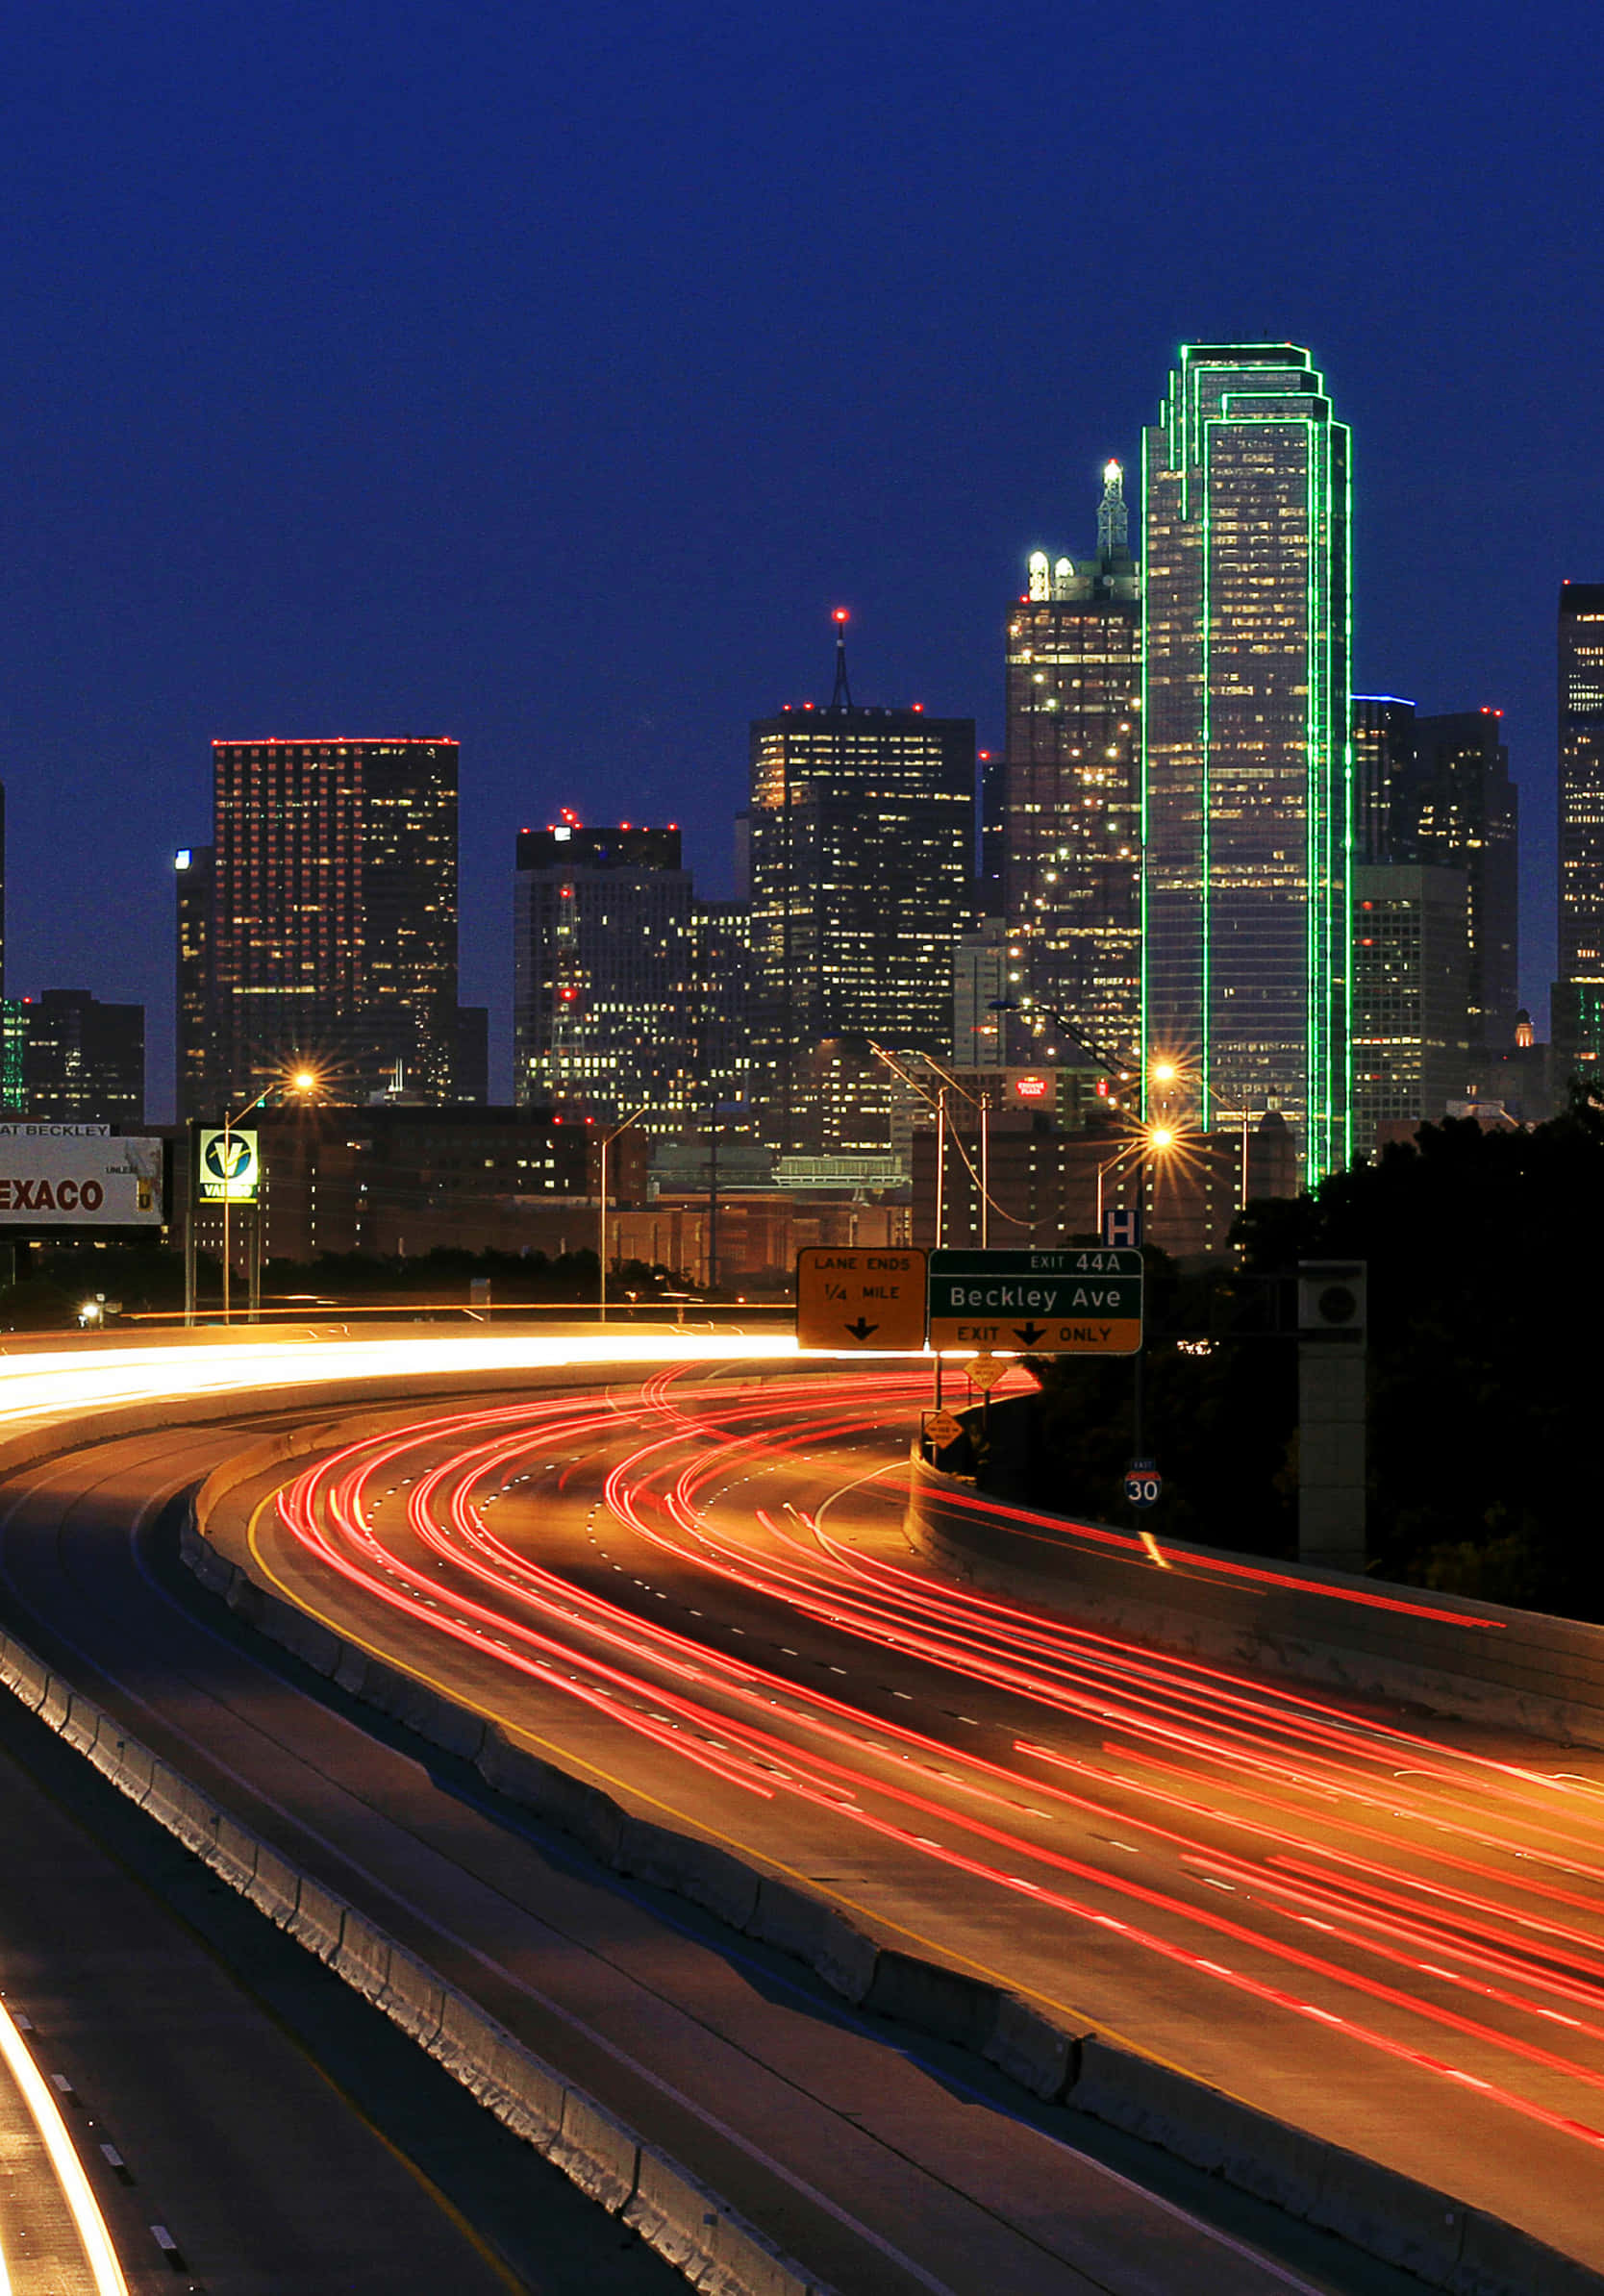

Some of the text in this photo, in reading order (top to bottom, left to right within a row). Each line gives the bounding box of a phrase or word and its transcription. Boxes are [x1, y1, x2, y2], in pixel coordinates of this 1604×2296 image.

[0, 1125, 108, 1136] AT BECKLEY
[815, 1258, 910, 1270] LANE ENDS
[1031, 1254, 1120, 1271] EXIT 44A
[863, 1286, 900, 1299] MILE
[950, 1287, 1120, 1311] Beckley Ave
[958, 1327, 1112, 1341] EXIT ONLY
[1128, 1481, 1158, 1500] 30
